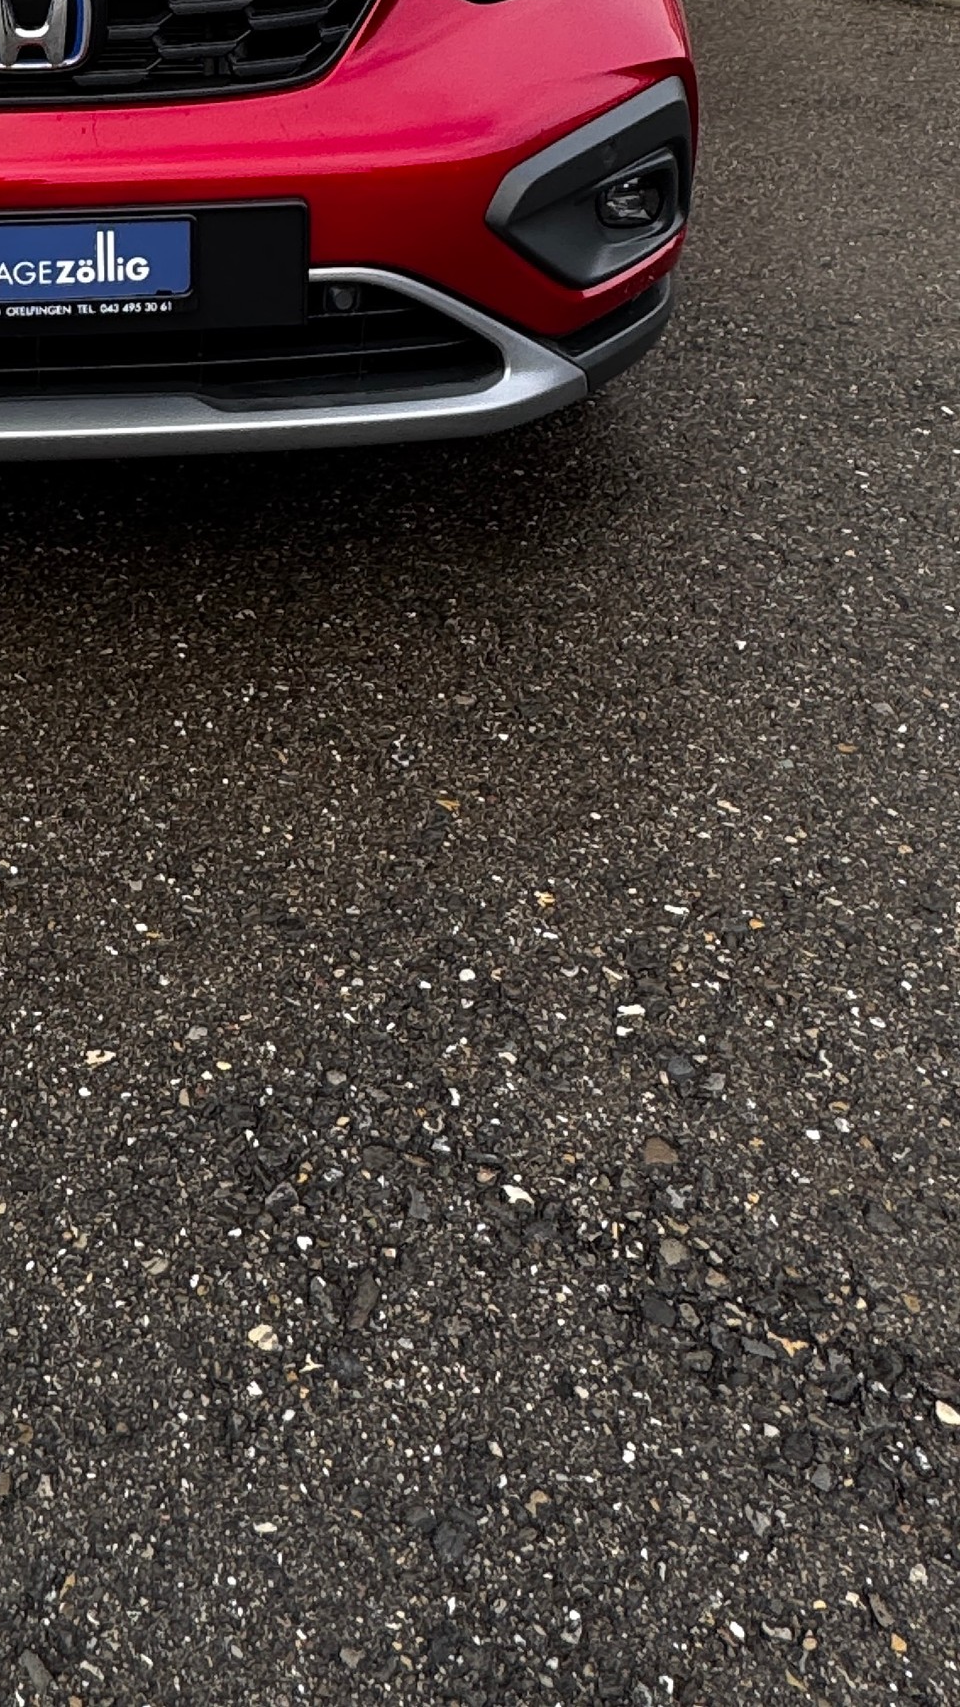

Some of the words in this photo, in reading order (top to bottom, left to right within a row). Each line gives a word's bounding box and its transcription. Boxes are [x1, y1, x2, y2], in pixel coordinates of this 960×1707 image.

[100, 303, 119, 314] 043
[122, 302, 141, 313] 495
[144, 302, 158, 312] 30
[160, 300, 173, 312] 61
